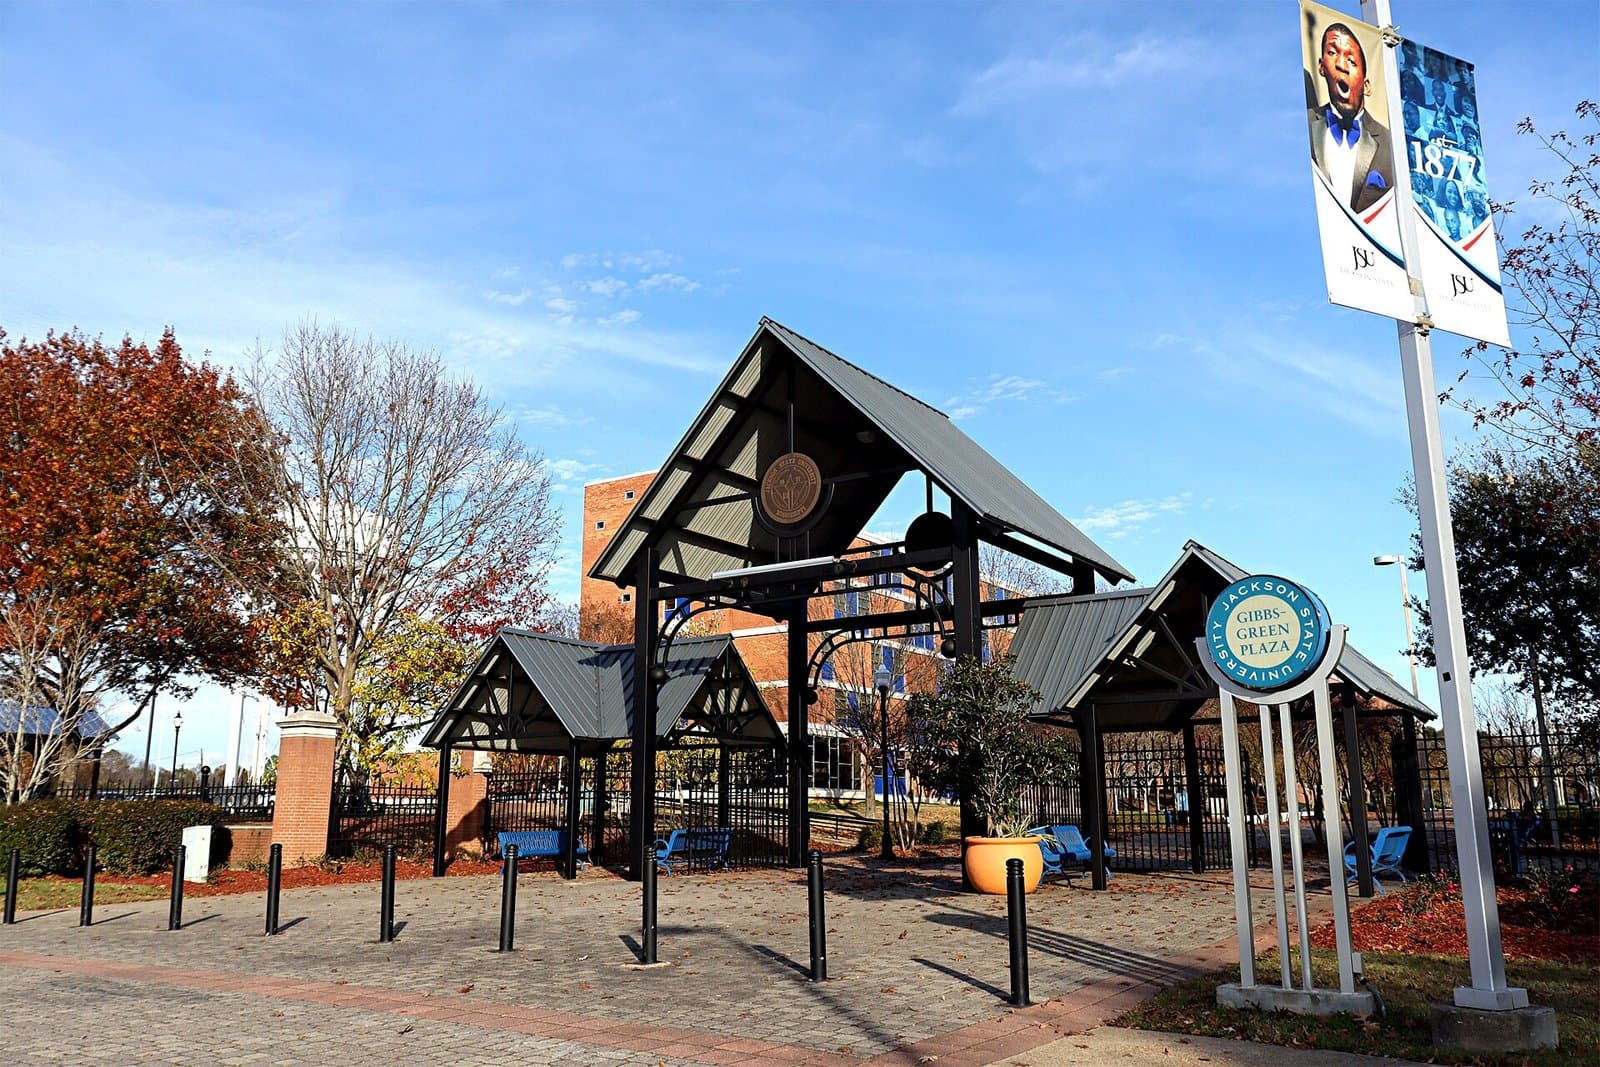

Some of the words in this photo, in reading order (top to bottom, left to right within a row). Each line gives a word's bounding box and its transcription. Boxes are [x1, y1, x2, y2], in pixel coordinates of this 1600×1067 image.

[1411, 141, 1477, 187] 1877
[1352, 245, 1375, 271] JSU
[1450, 273, 1474, 297] JSU
[1221, 581, 1300, 611] JACKSON
[1236, 608, 1286, 623] GIBBS-
[1236, 623, 1290, 640] GREEN
[1295, 607, 1314, 662] STATE
[1212, 621, 1293, 681] UNIVERSITY
[1240, 640, 1290, 656] PLAZA
